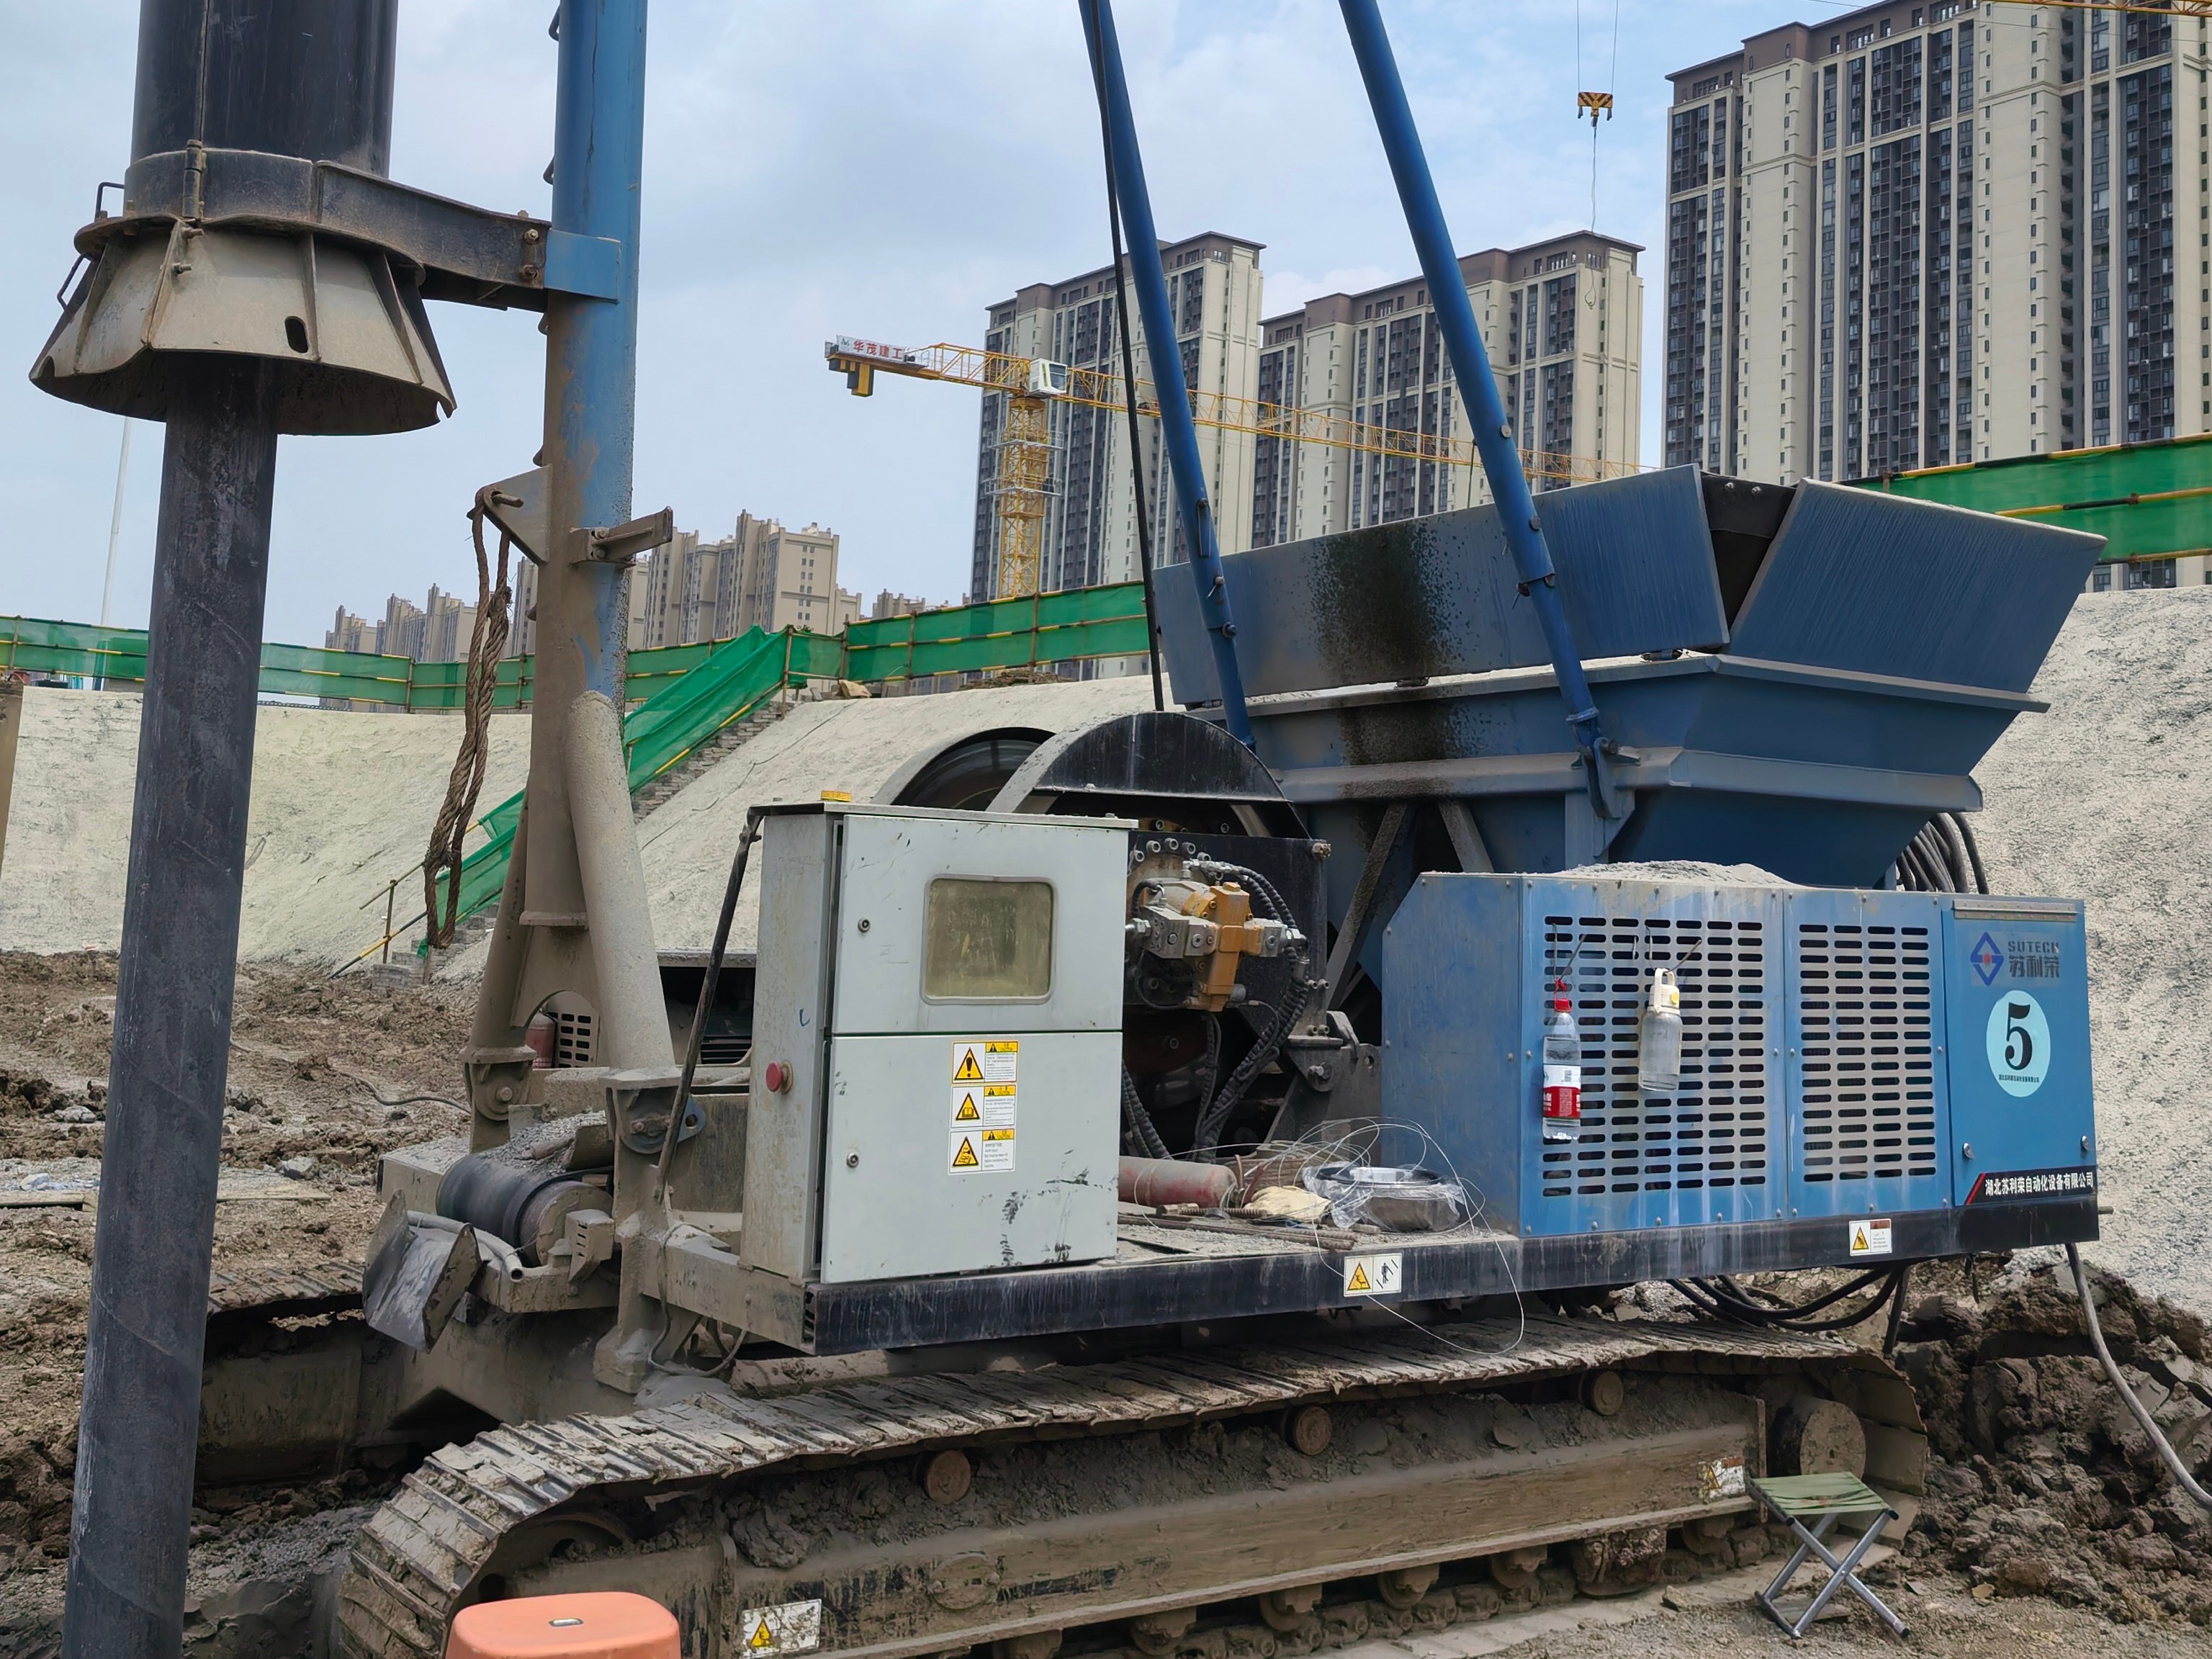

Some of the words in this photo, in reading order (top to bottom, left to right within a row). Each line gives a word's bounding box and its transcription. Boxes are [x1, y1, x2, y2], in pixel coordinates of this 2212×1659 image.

[853, 339, 903, 359] 华茂建工
[2005, 1002, 2033, 1071] 5
